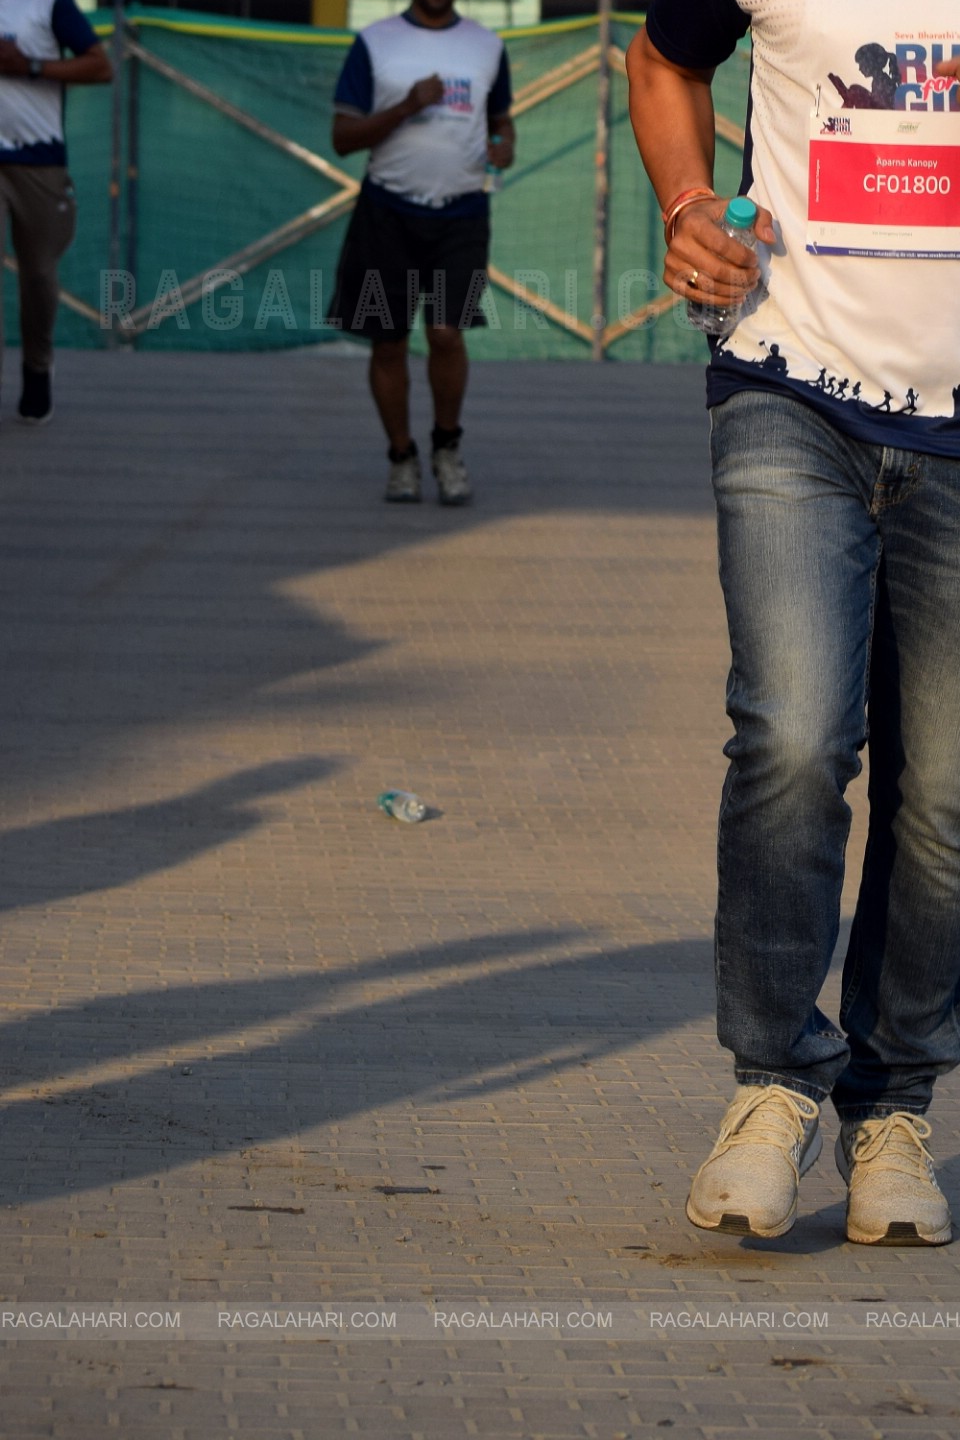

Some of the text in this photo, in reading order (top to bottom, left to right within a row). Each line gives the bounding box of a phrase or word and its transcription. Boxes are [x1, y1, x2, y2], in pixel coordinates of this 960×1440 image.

[876, 157, 938, 169] Aparna Kanopy
[863, 174, 951, 194] CF01800
